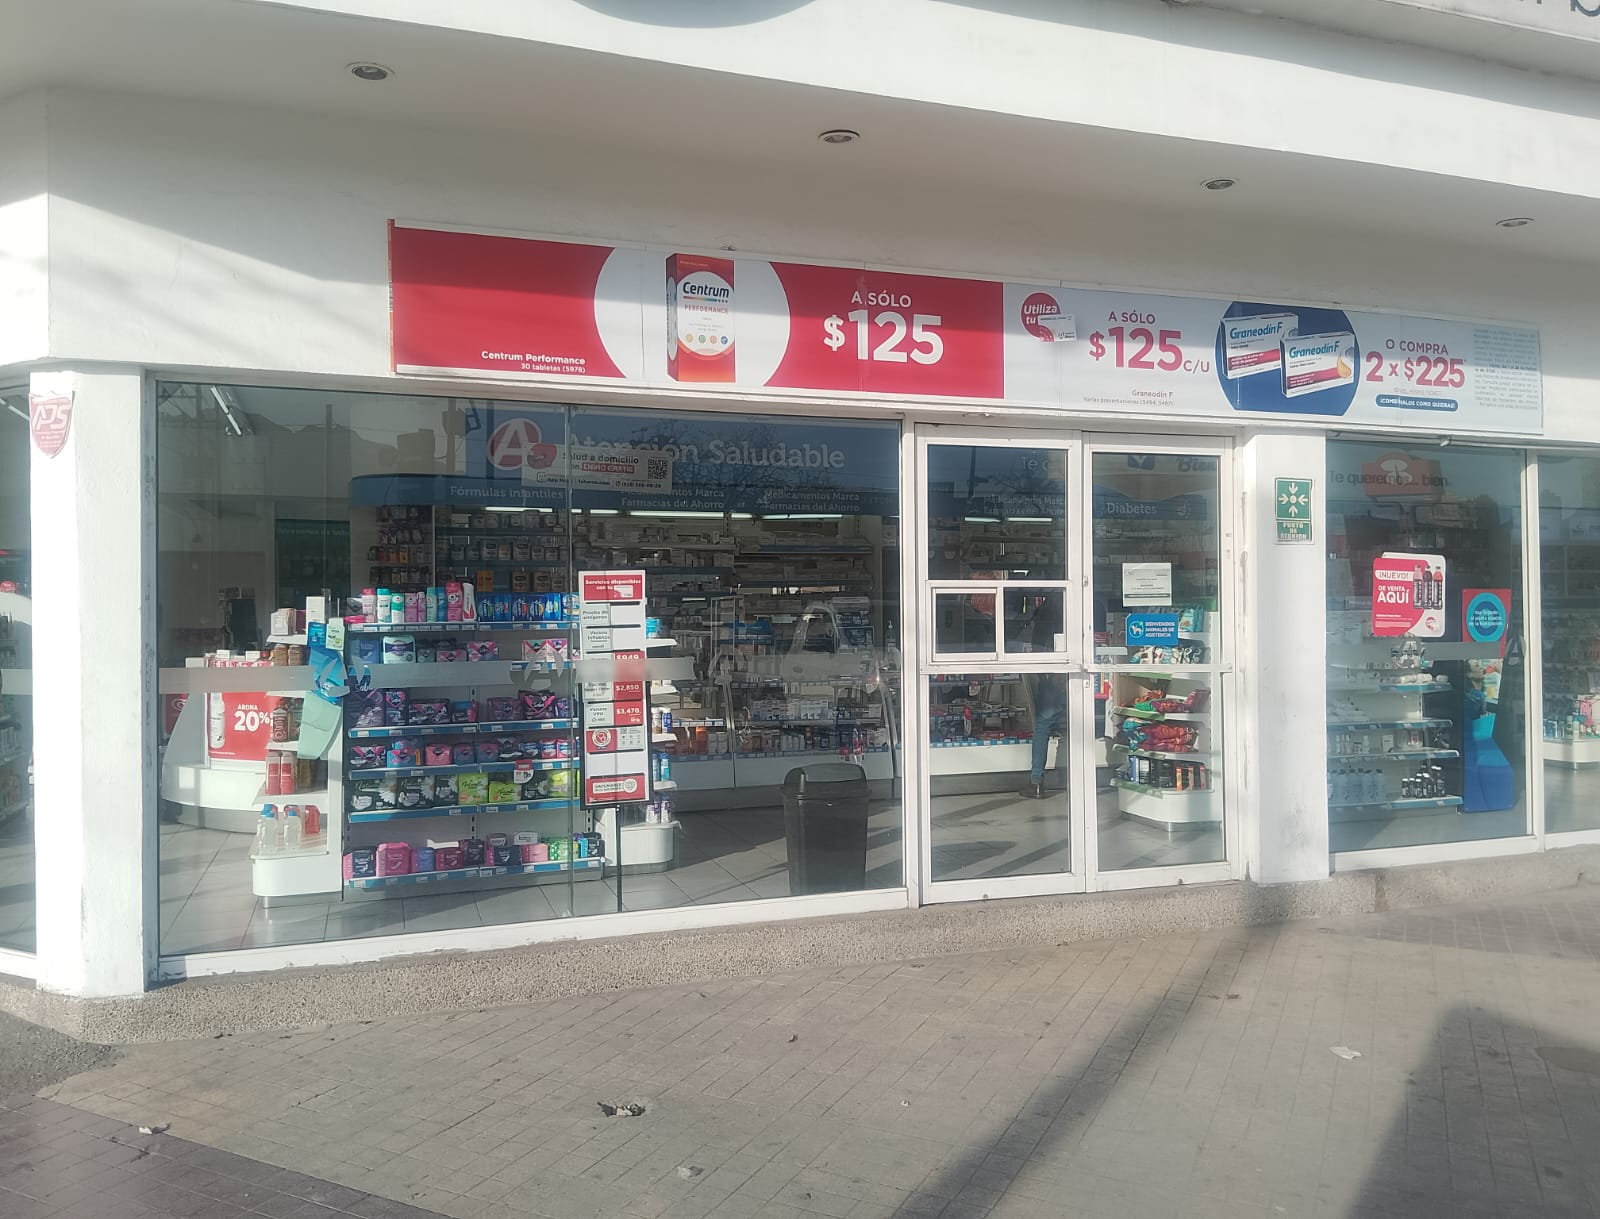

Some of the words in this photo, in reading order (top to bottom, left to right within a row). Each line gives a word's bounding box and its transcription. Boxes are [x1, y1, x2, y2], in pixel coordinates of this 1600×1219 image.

[682, 281, 730, 298] Centrum
[851, 291, 863, 304] A
[868, 289, 912, 308] SÓLO
[684, 304, 729, 314] PERFORMANCE
[1023, 304, 1058, 315] Utiliza
[1026, 315, 1036, 325] tu
[1108, 311, 1118, 322] A
[1121, 309, 1156, 325] SÓLO
[823, 309, 944, 365] $125
[1089, 326, 1183, 371] $125
[1183, 360, 1210, 374] C/U
[1385, 339, 1395, 350] O
[1399, 341, 1449, 356] COMPRA
[481, 350, 523, 361] Centrum
[525, 353, 586, 365] Performance
[521, 362, 531, 370] 30
[532, 363, 561, 372] tabletas
[1365, 351, 1384, 382] 2
[597, 452, 640, 464] domicilio
[707, 438, 846, 469] Saludable
[1328, 471, 1345, 484] Te
[450, 485, 506, 498] Fórmulas
[509, 487, 565, 500] infantiles
[695, 488, 724, 498] Marca
[764, 488, 832, 501] Medicamentos
[833, 491, 860, 502] Marca
[621, 497, 671, 508] Farmacias
[673, 498, 689, 508] del
[690, 499, 725, 510] Ahorro
[764, 501, 811, 512] Farmacias
[812, 502, 828, 512] del
[828, 502, 860, 513] Ahorro
[1106, 502, 1157, 514] Diabetes
[1387, 585, 1406, 593] VENTA
[1377, 589, 1410, 604] AQUÍ
[233, 710, 270, 732] 20%
